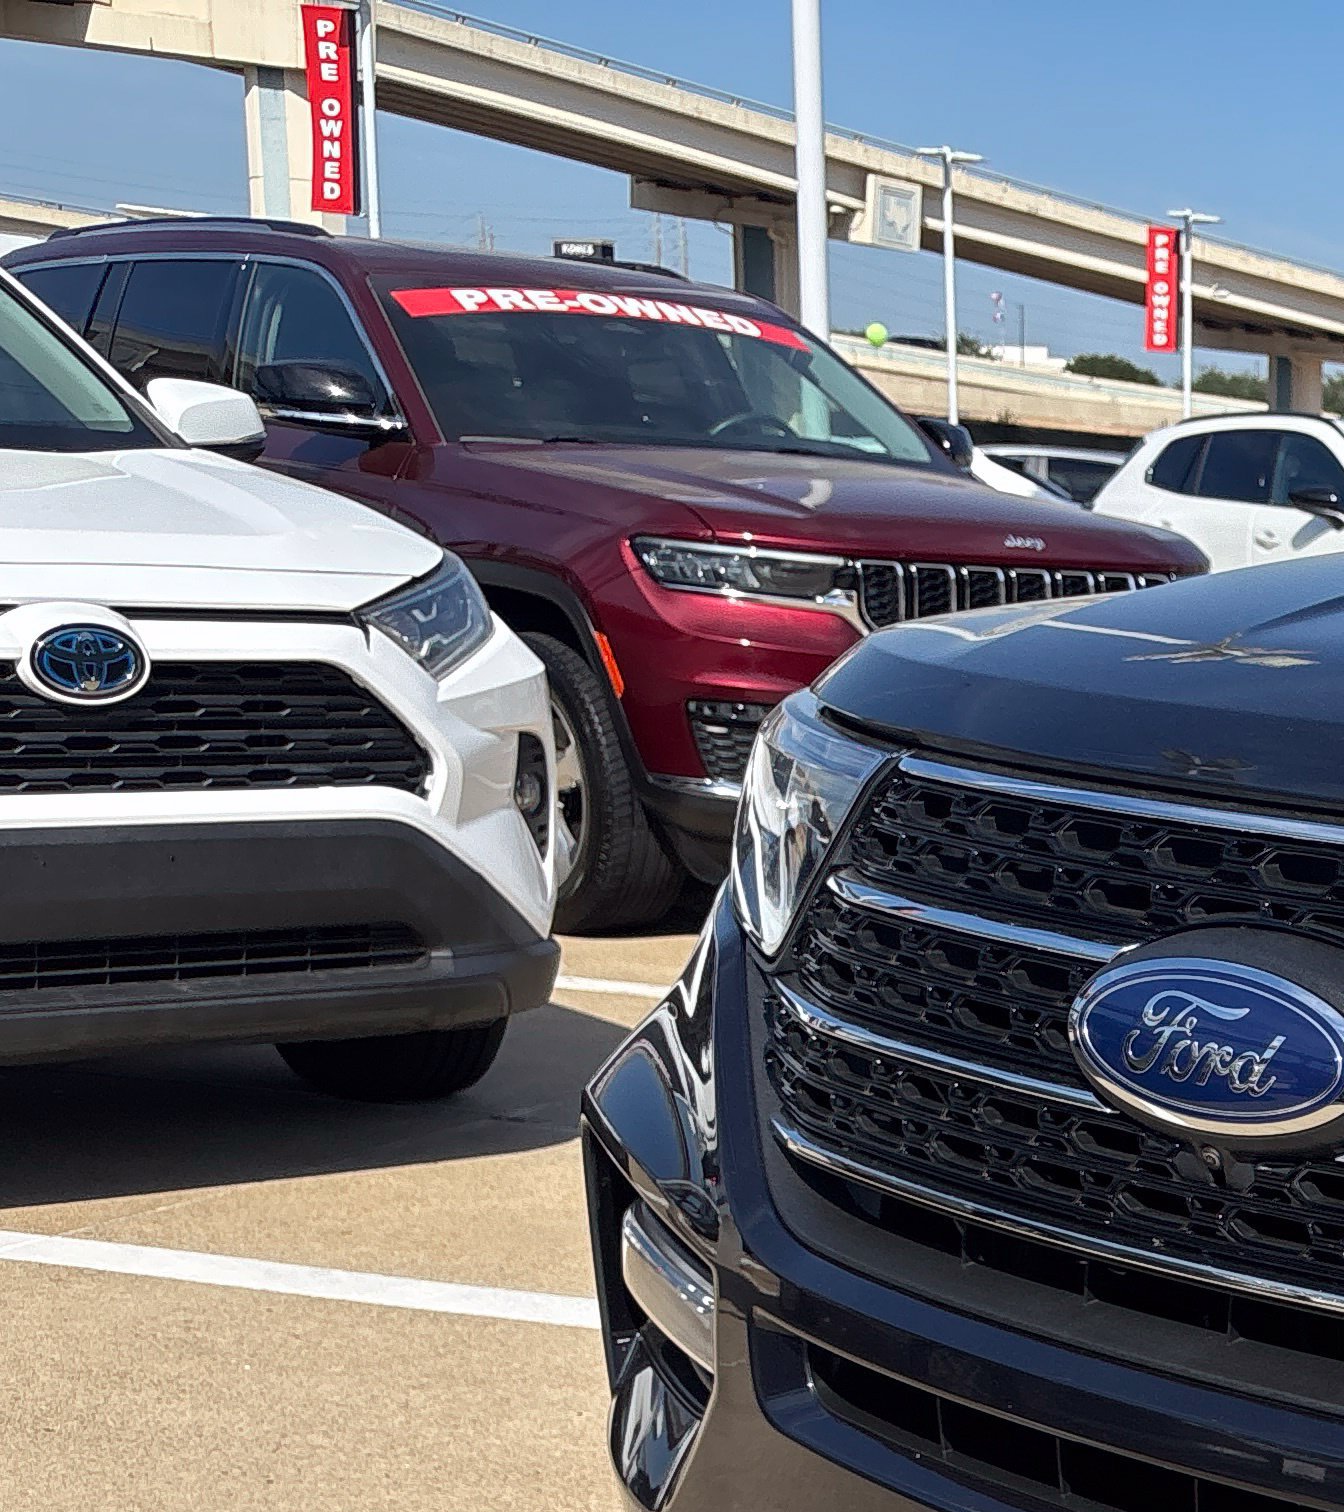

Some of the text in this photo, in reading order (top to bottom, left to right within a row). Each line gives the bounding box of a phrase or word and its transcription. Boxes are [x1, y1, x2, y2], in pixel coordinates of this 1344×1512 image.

[316, 19, 343, 200] PRE OWNED
[449, 288, 763, 338] PRE-OWNED
[1151, 233, 1171, 346] PRE OWNED
[1122, 989, 1288, 1098] Ford
